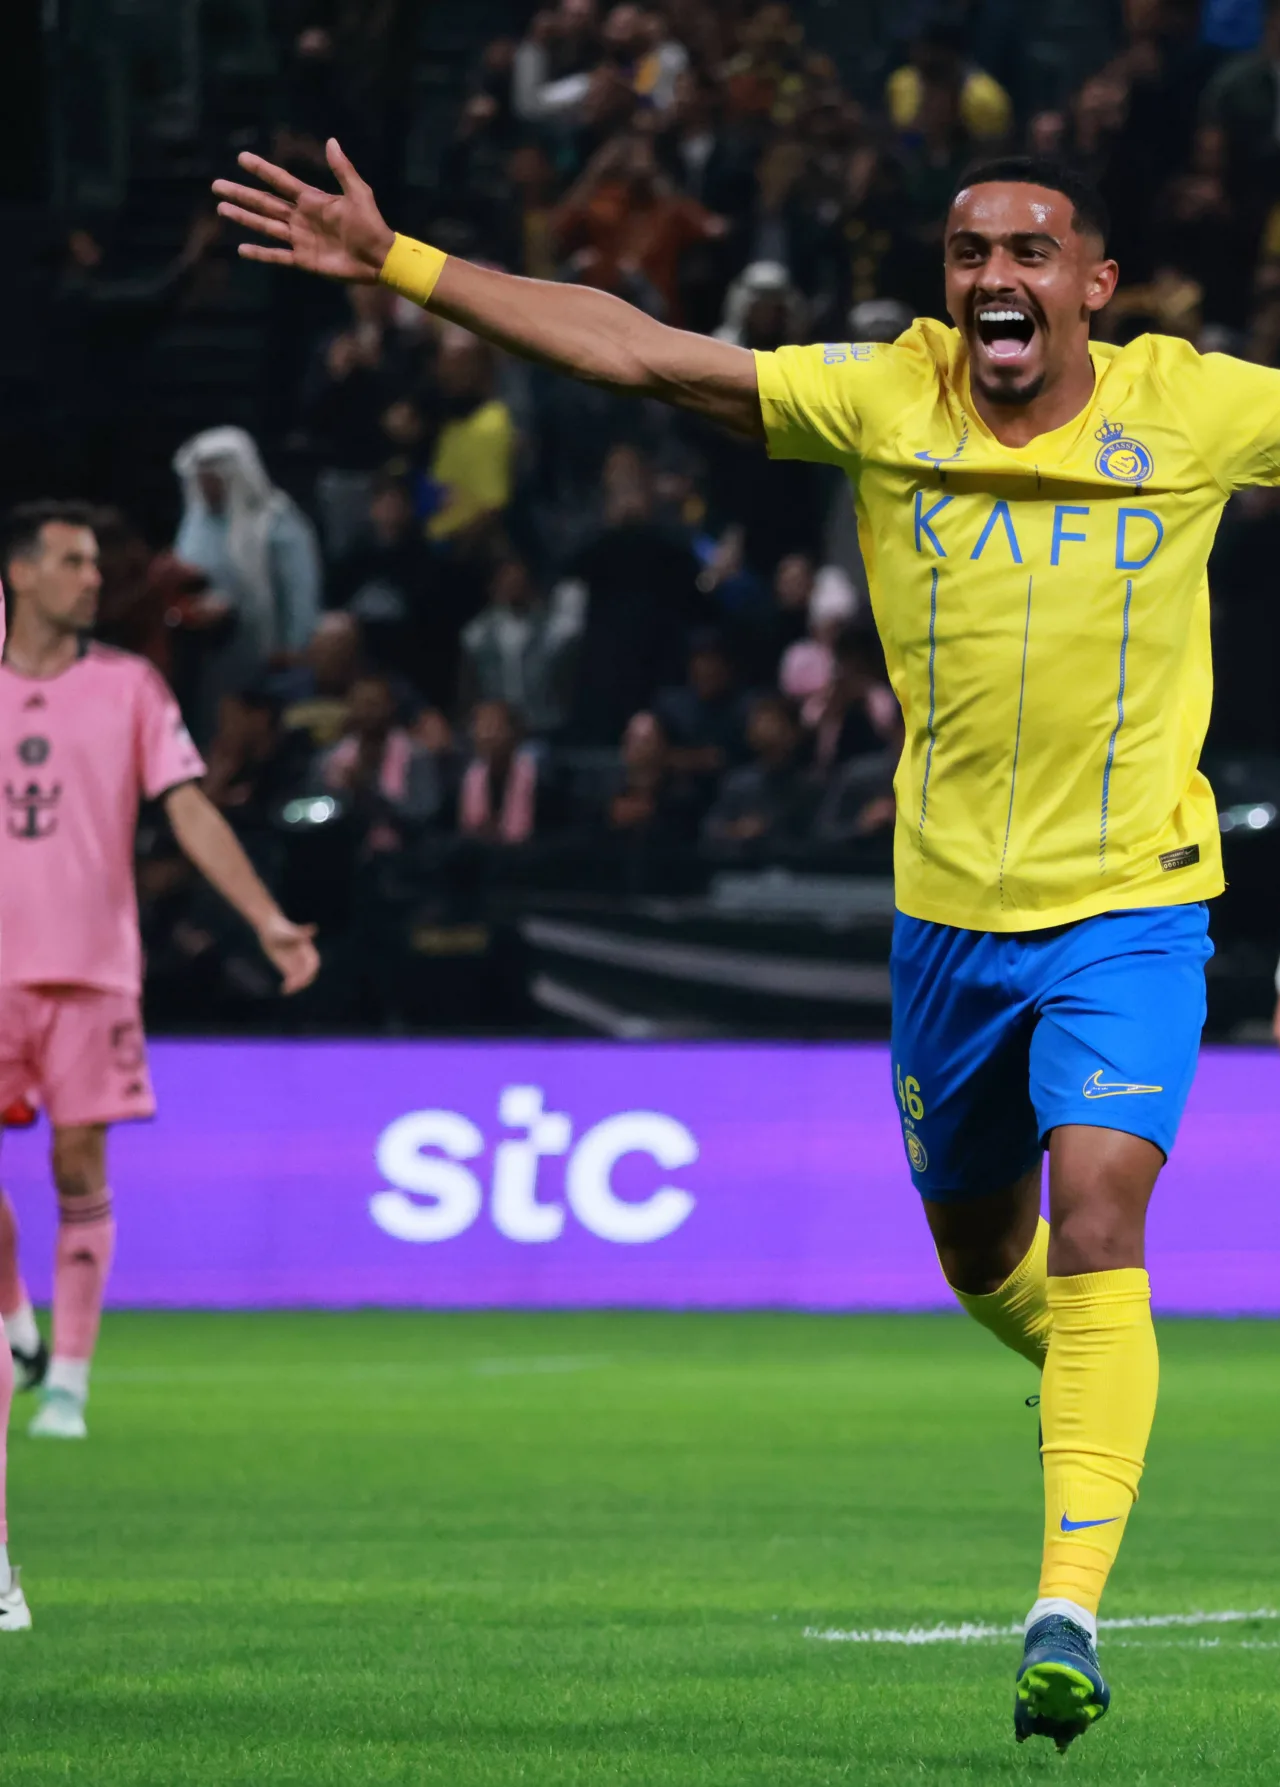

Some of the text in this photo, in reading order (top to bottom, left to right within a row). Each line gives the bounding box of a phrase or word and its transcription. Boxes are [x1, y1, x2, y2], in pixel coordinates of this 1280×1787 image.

[1108, 442, 1137, 453] NASSR
[914, 491, 1164, 570] KAFD
[369, 1083, 700, 1244] stc
